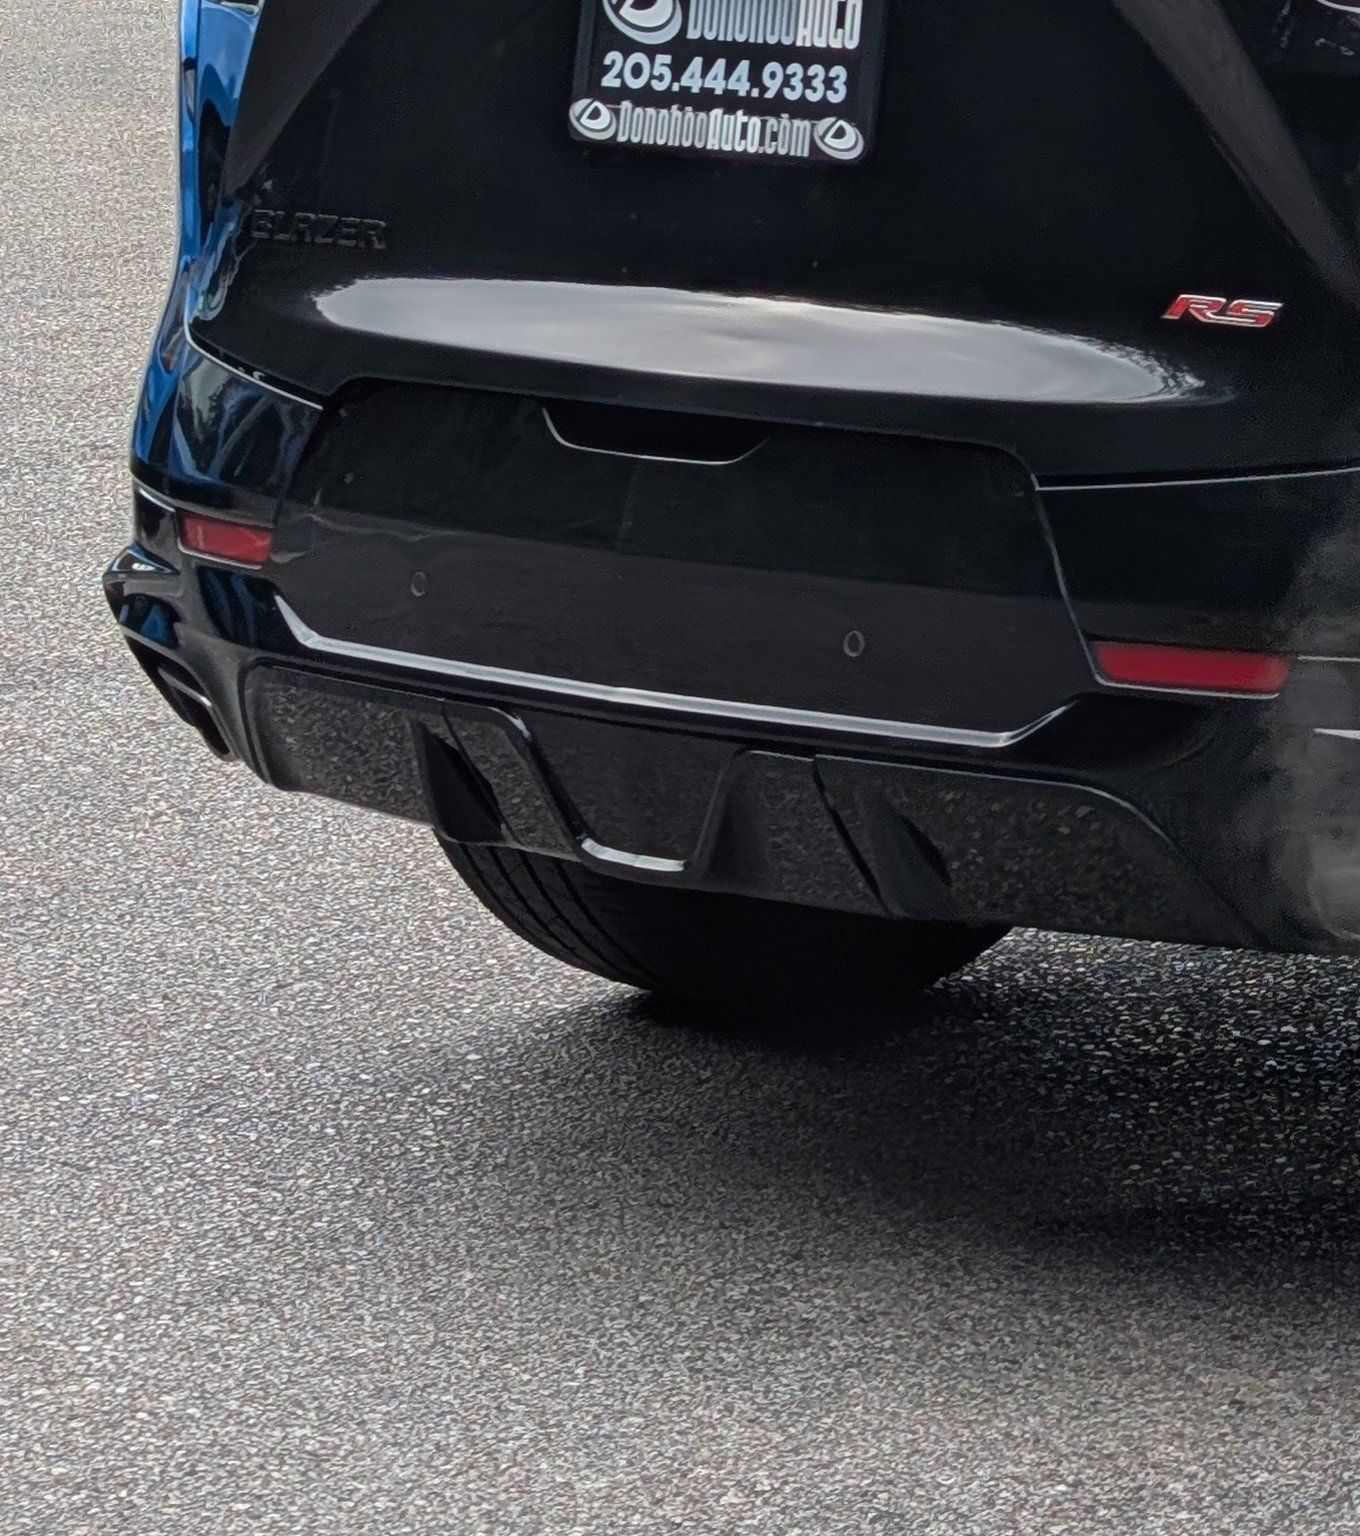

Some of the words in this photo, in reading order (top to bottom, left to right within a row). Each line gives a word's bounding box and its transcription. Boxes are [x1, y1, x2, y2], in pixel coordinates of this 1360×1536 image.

[601, 50, 848, 104] 205.444.9333
[617, 100, 812, 158] DonohooAuto.com
[1160, 294, 1285, 329] RS
